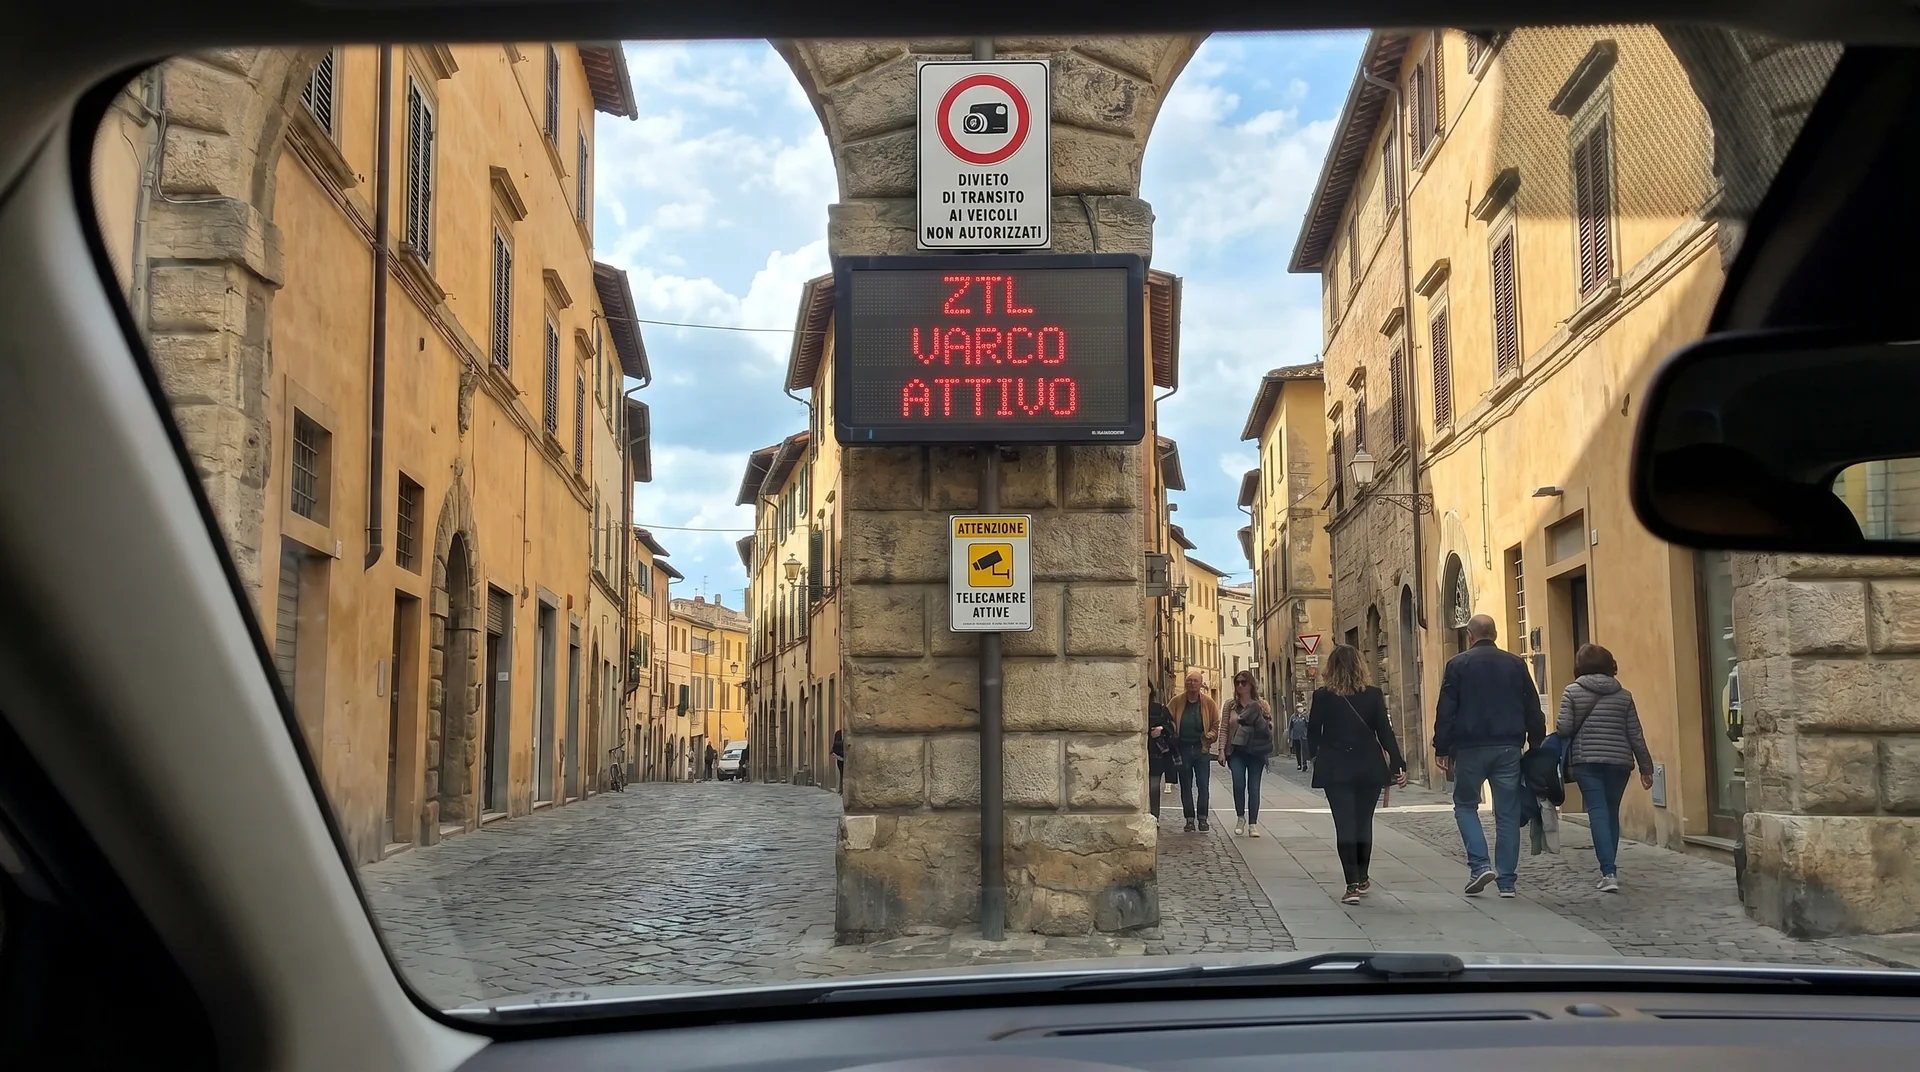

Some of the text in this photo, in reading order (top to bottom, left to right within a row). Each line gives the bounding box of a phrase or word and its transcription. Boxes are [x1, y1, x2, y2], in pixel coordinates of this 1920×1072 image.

[958, 173, 1009, 187] DIVIETO
[942, 190, 1025, 204] DI TRANSITO
[949, 208, 1018, 222] AI VEICOLI
[926, 225, 1042, 239] NON AUTORIZZATI
[943, 274, 1034, 316] ZTL
[911, 325, 1067, 367] VARCO
[901, 376, 1078, 418] ATTIVO
[957, 522, 1024, 534] ATTENZIONE
[956, 592, 1026, 604] TELECAMERE
[972, 606, 1010, 618] ATTIVE
